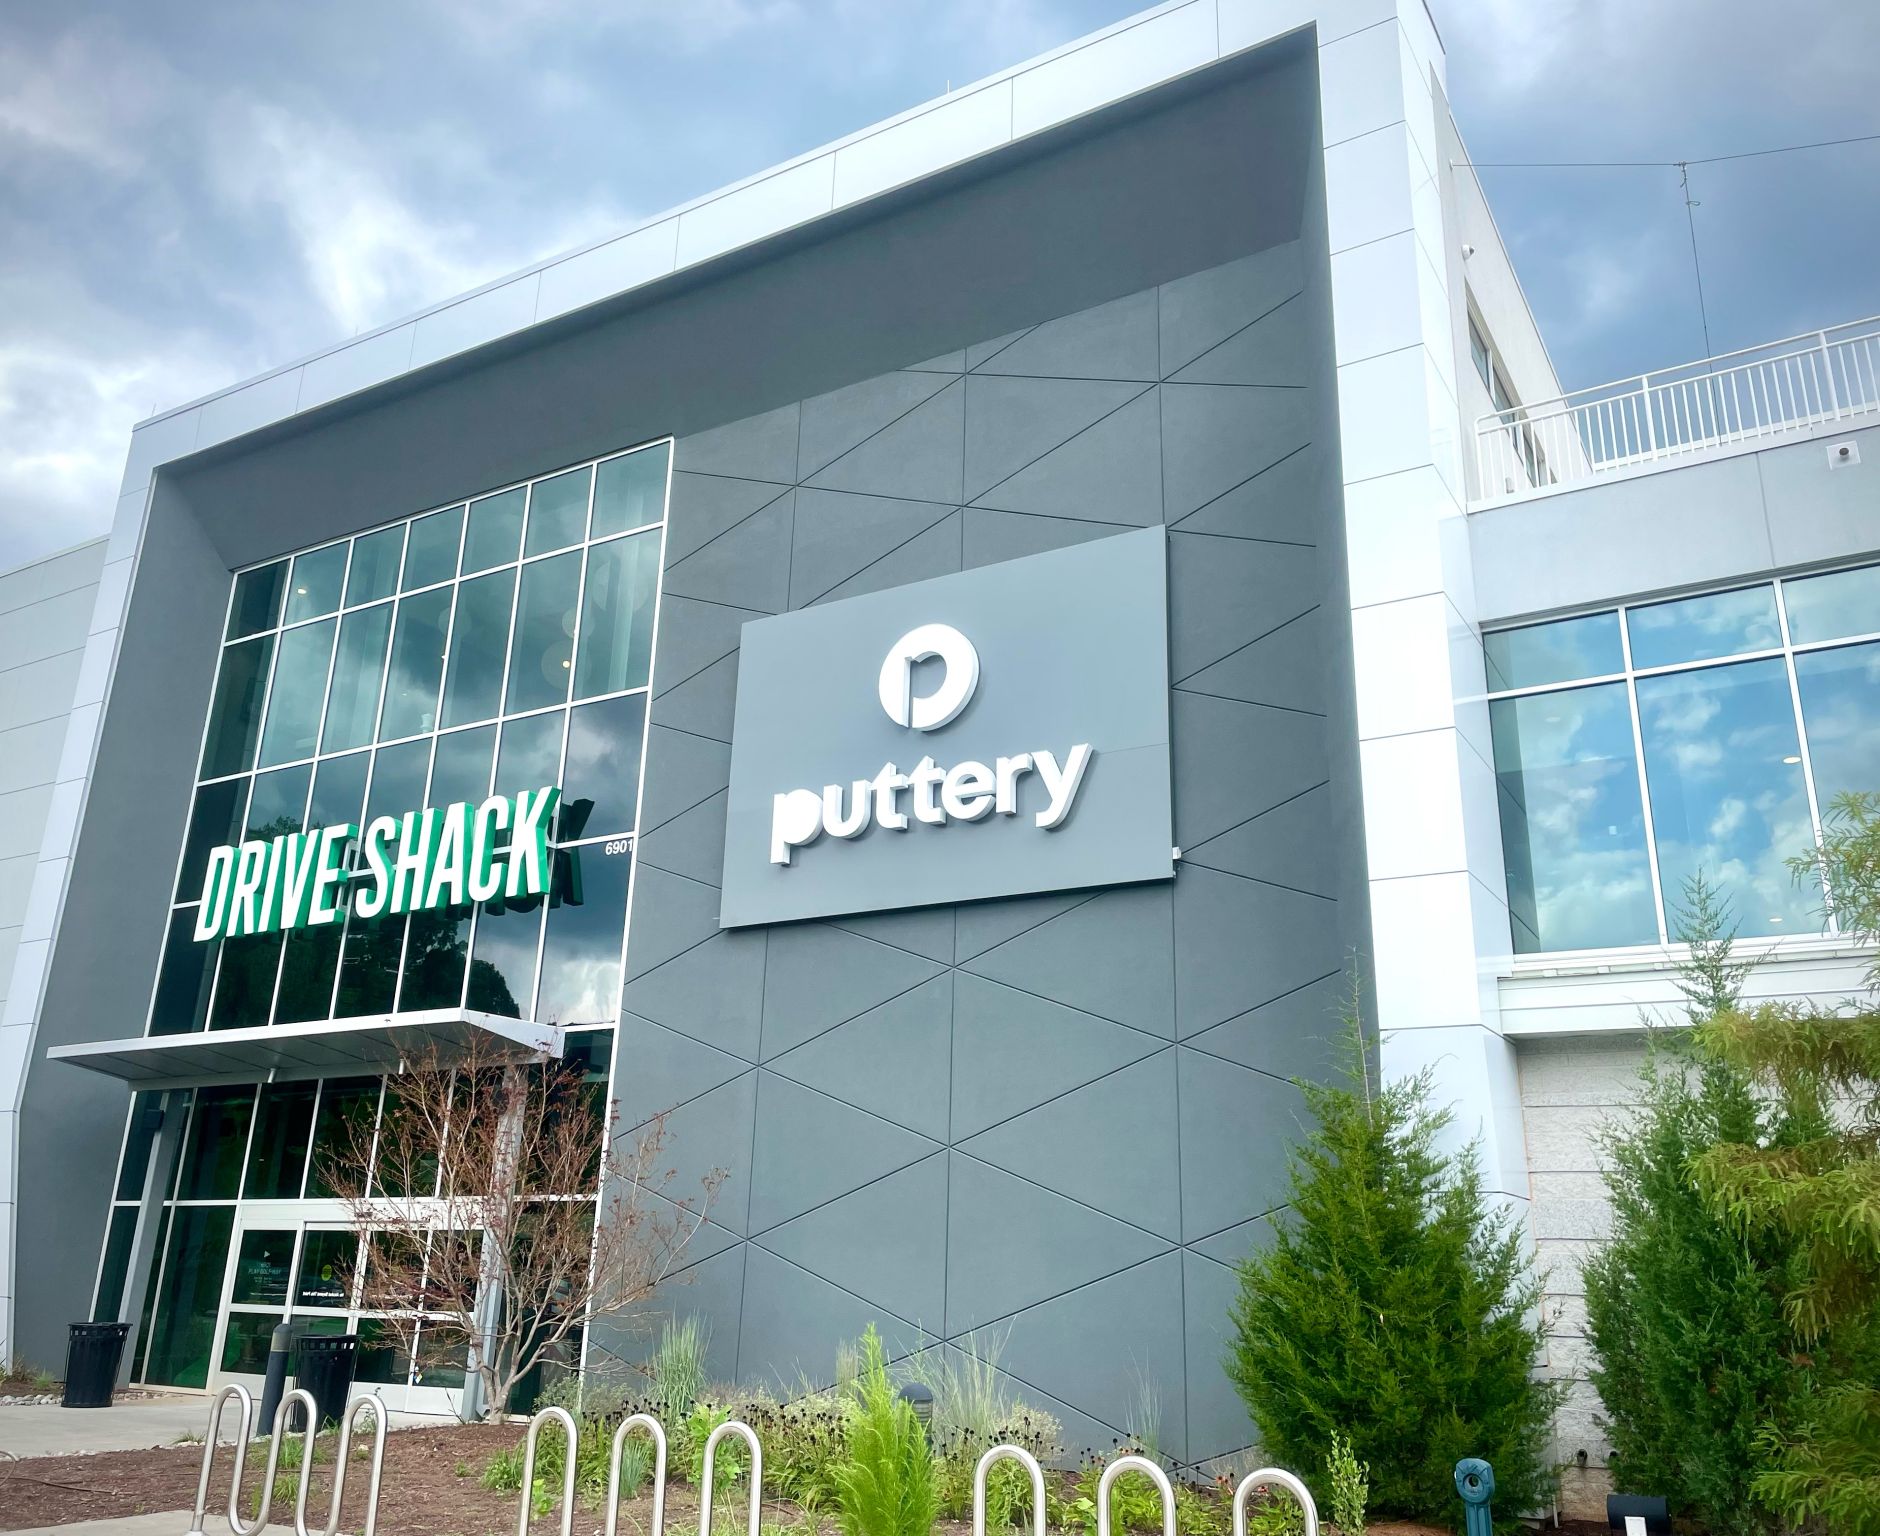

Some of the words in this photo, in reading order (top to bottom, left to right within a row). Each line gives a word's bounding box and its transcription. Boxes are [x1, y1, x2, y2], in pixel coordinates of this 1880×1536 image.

[194, 824, 357, 942] DRIVE
[355, 786, 560, 919] SHACK
[605, 839, 633, 855] 6901
[770, 743, 1092, 865] puttery
